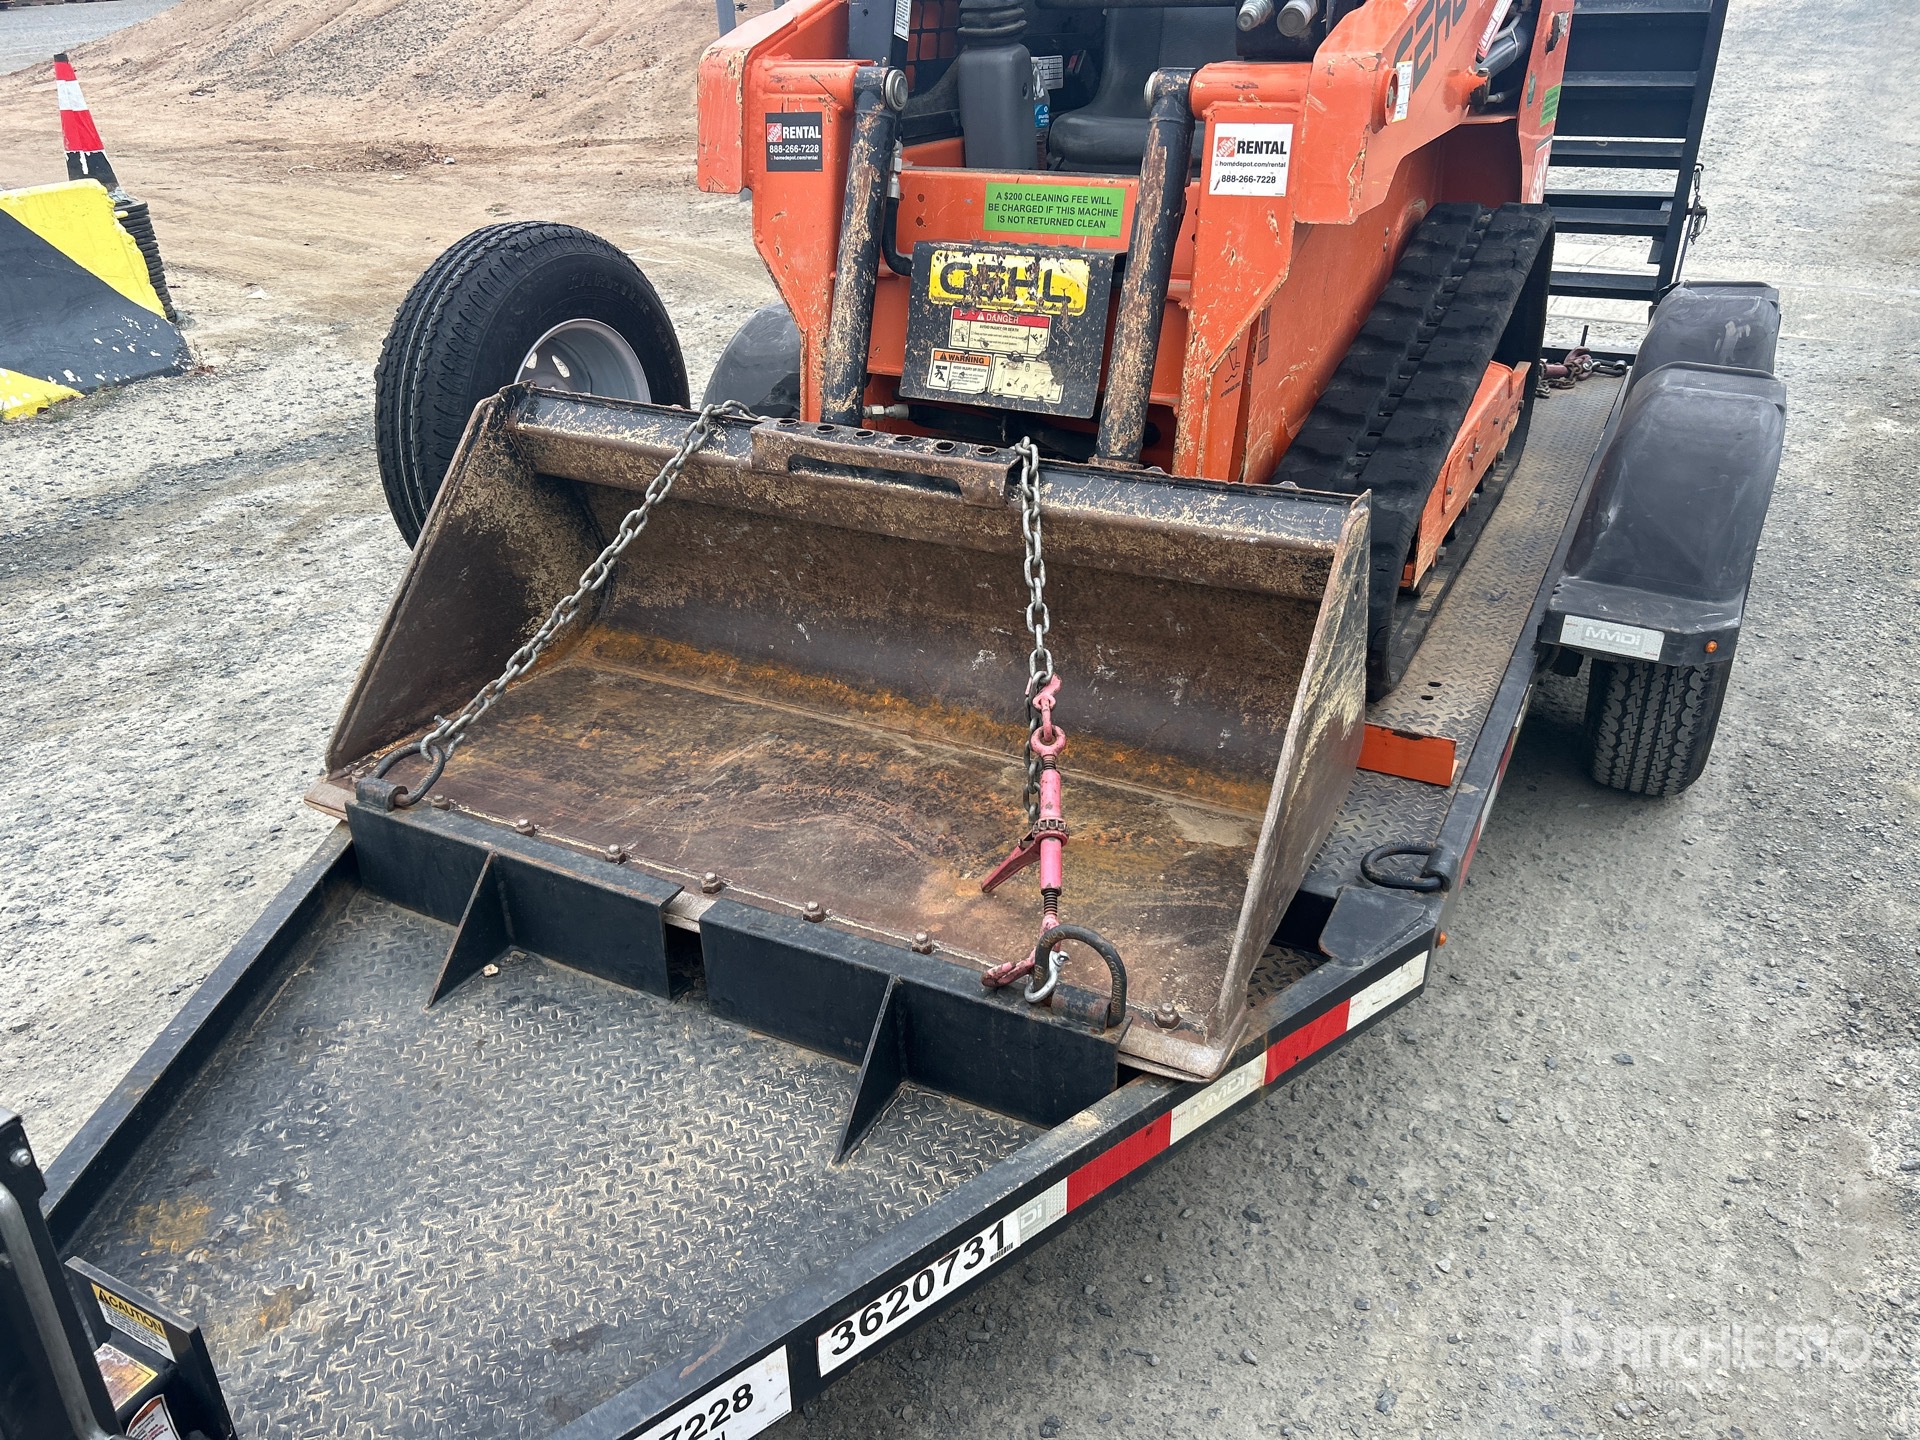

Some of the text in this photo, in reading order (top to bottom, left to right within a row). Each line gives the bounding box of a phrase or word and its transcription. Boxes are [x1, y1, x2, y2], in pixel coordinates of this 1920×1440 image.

[782, 125, 822, 139] RENTAL
[769, 144, 820, 154] 888-266-7228
[1236, 140, 1287, 155] RENTAL
[1219, 160, 1286, 168] homedepot.com/rental
[1221, 174, 1276, 184] 888-266-7228
[996, 192, 1112, 205] A $200 CLEANING FEE WILL
[988, 203, 1118, 217] BE CHARGED IF THIS MACHINE
[997, 215, 1106, 228] IS NOT RETURNED CLEAN
[986, 313, 1019, 324] DANGER
[948, 353, 985, 365] WARNING
[831, 1220, 1004, 1356] 3620731
[108, 1296, 163, 1334] CAUTION
